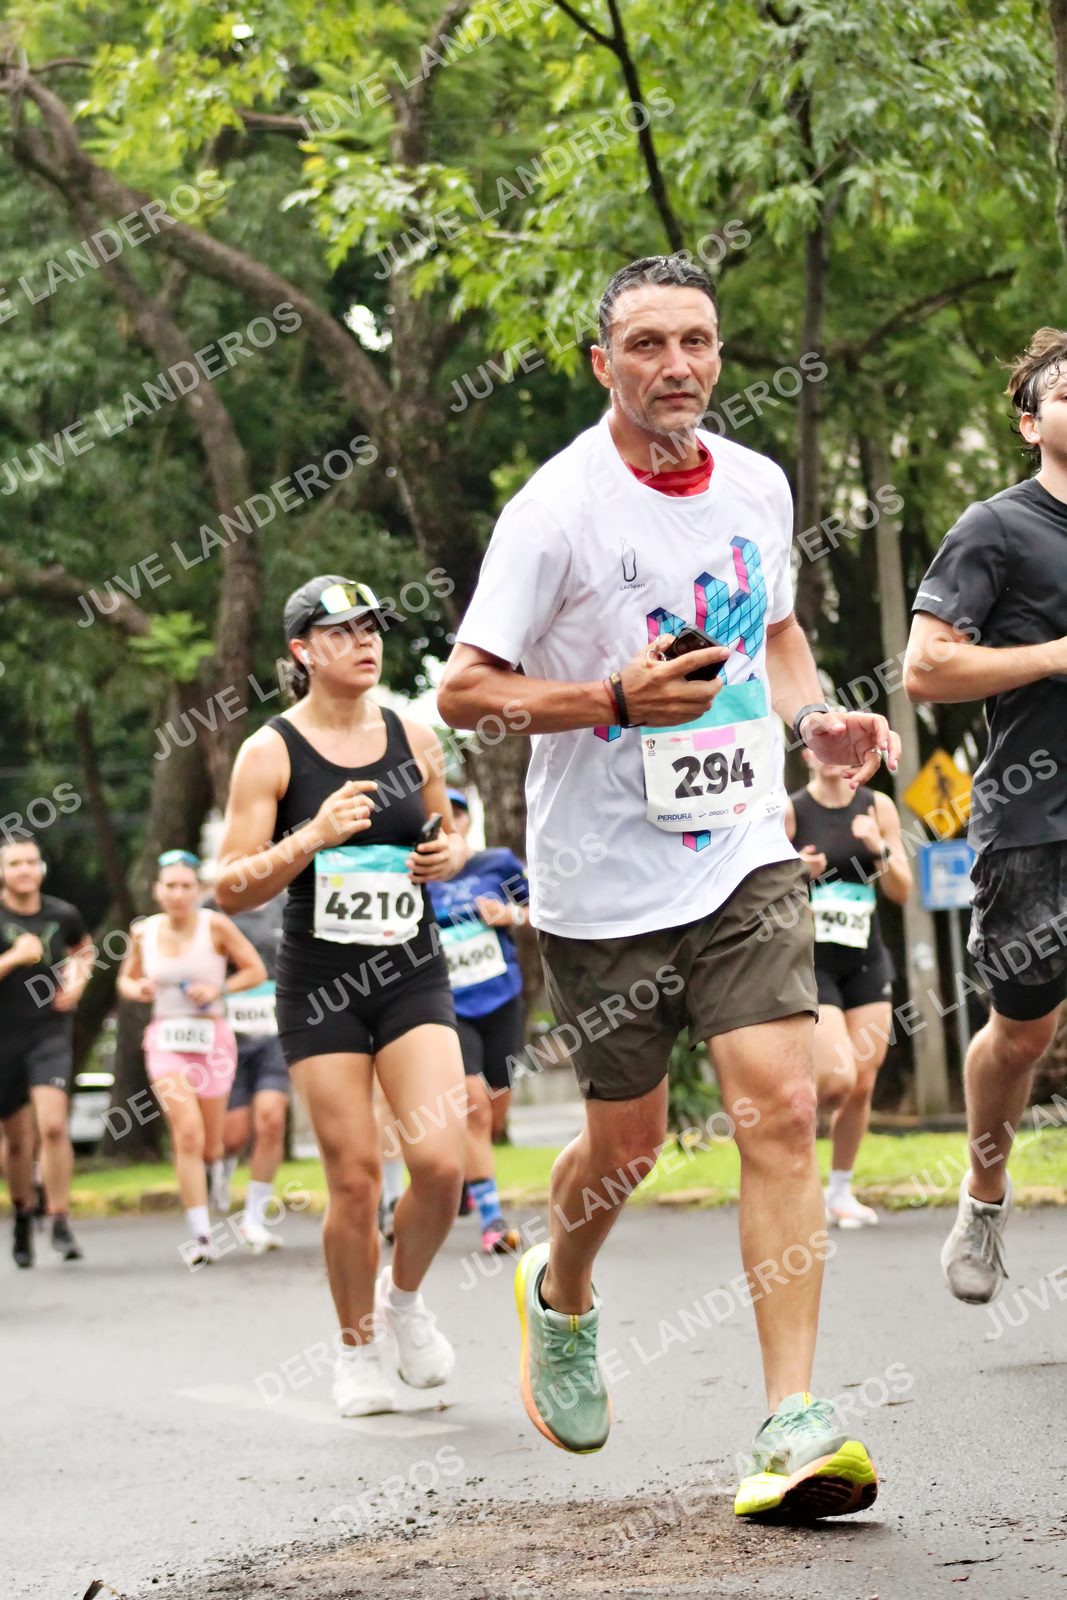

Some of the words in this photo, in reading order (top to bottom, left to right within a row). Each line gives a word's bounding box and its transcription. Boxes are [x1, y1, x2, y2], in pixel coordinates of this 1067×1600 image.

[671, 747, 755, 799] 294
[657, 812, 693, 822] PERDURA
[325, 891, 416, 920] 4210
